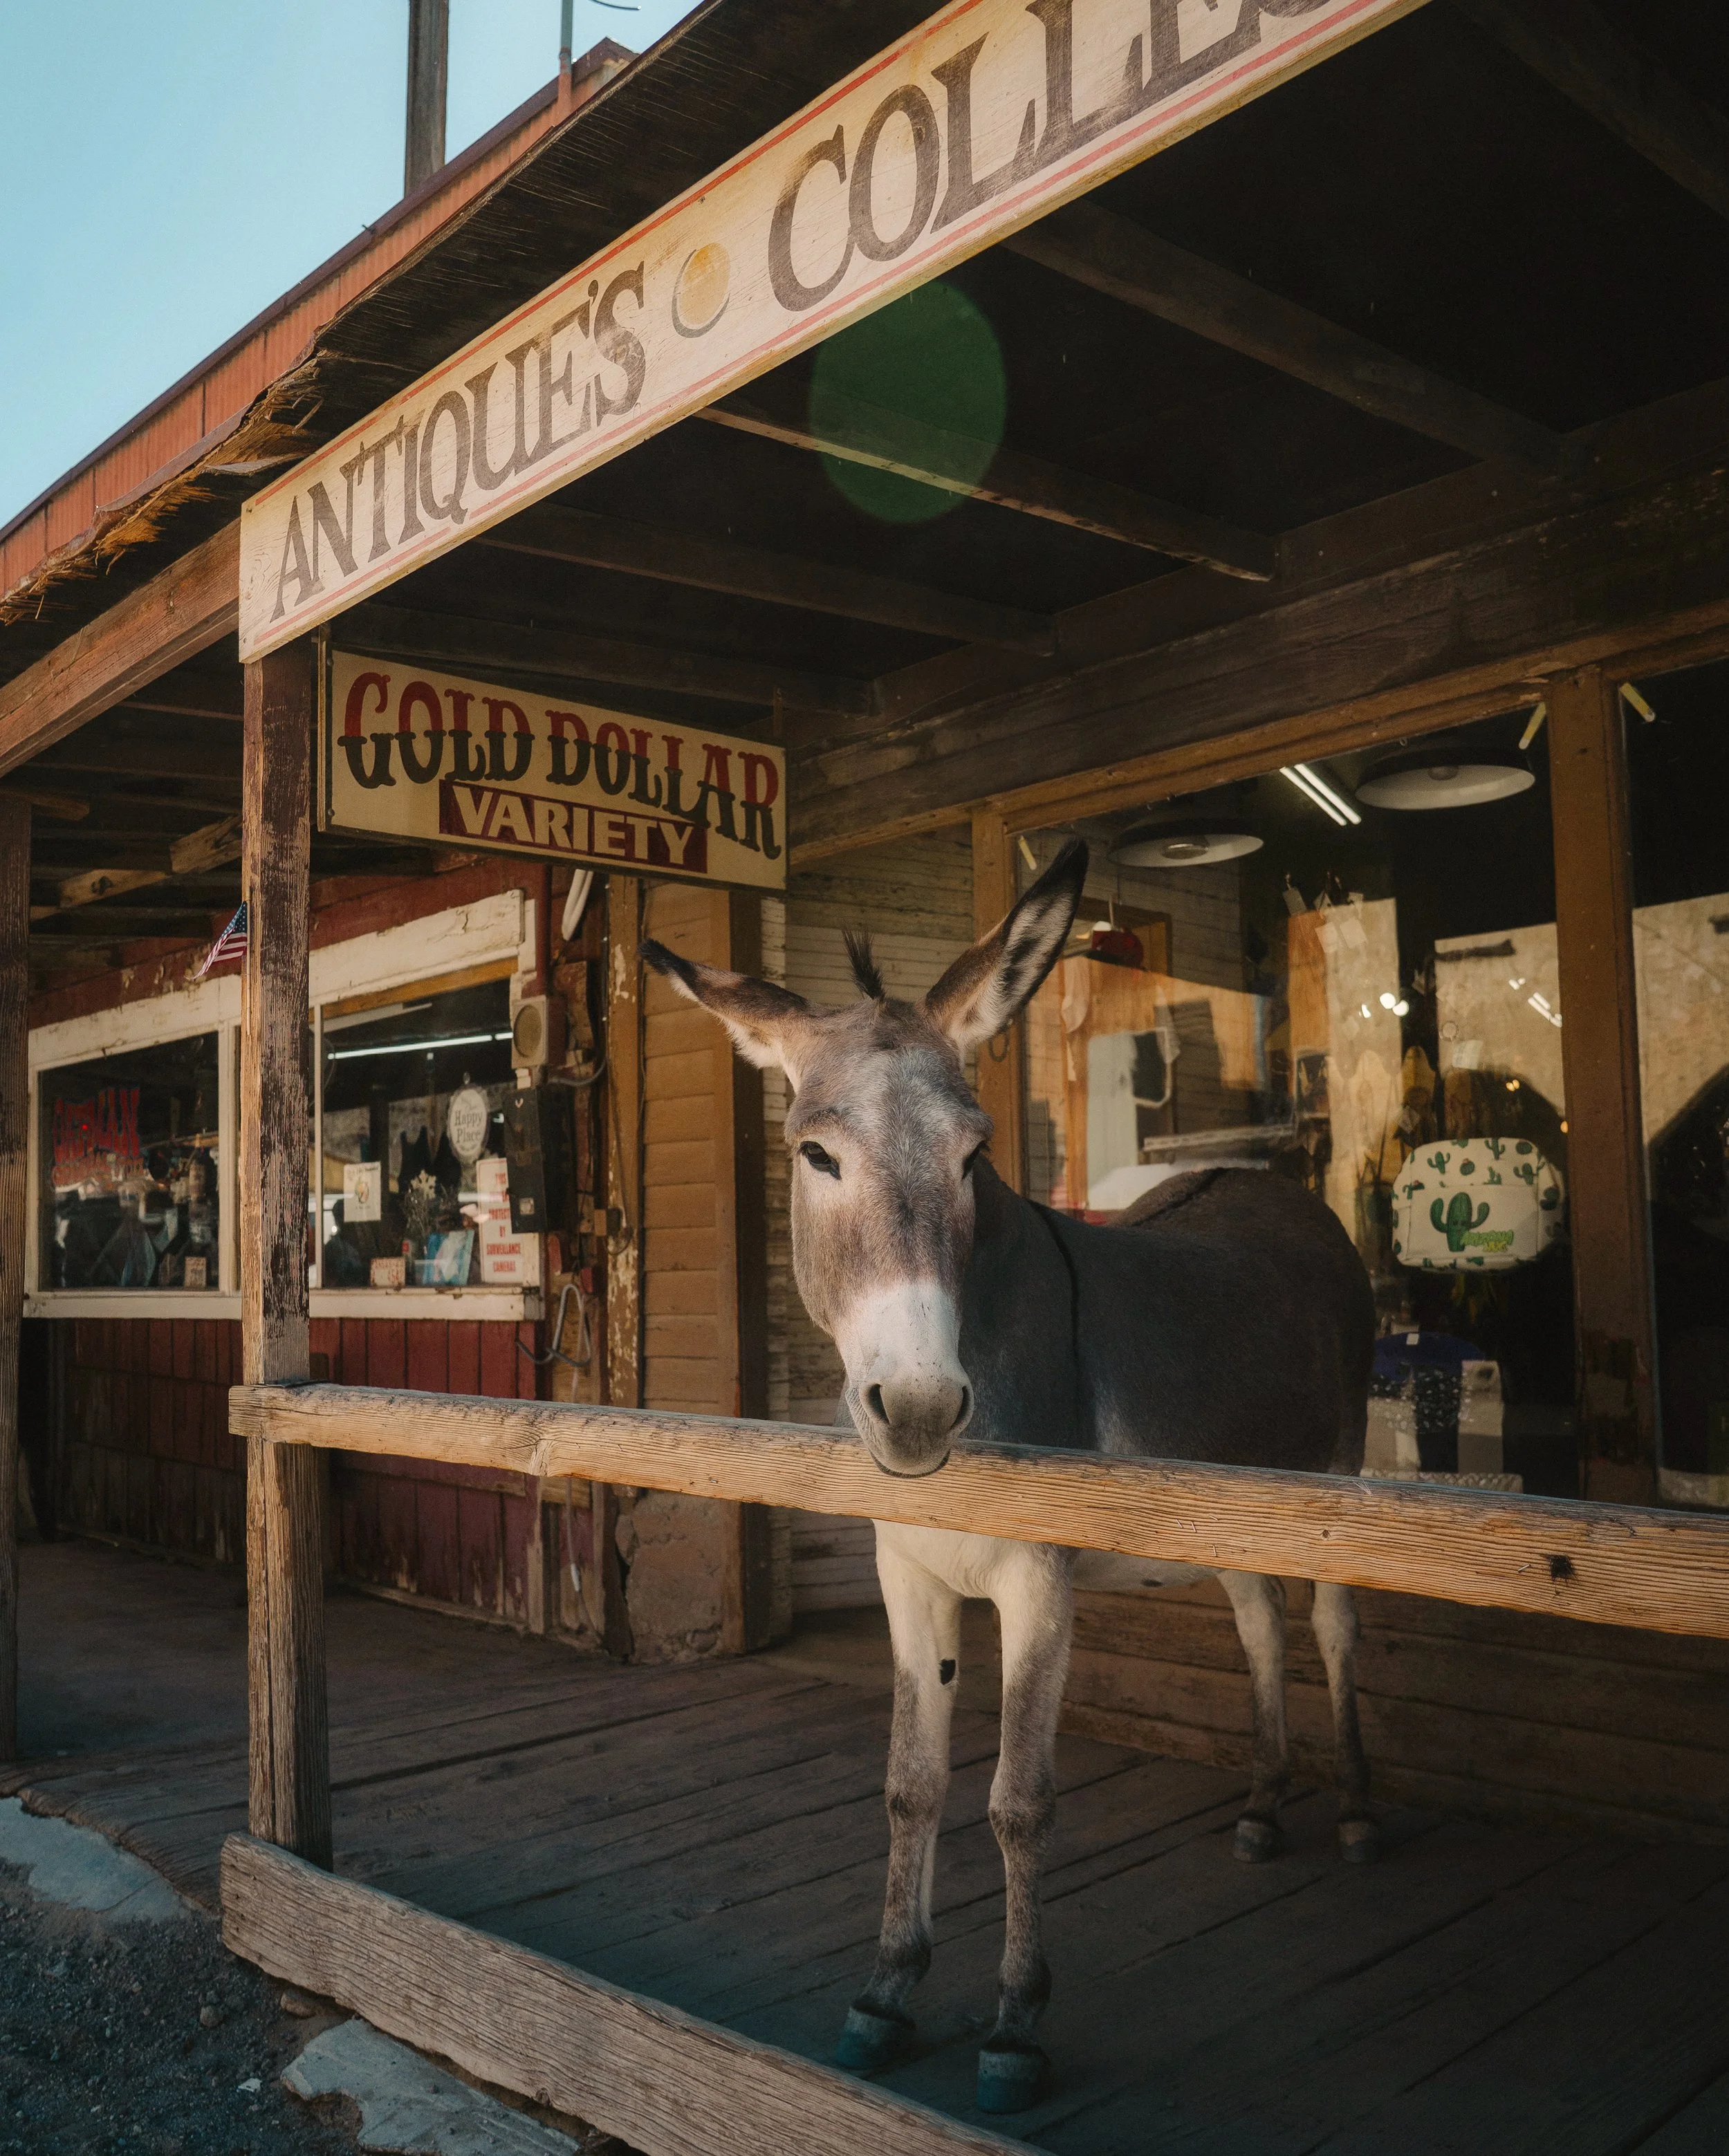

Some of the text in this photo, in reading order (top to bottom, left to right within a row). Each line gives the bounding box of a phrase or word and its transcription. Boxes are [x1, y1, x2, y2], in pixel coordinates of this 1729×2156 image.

[270, 0, 1329, 621] ANTIQUE'S COLLE
[337, 671, 782, 859] GOLD DOLLAR
[453, 785, 694, 864] VARIETY
[454, 1110, 483, 1128] Happy
[456, 1128, 481, 1143] Place
[489, 1207, 510, 1220] PROTECT
[487, 1243, 521, 1256] SURVEILLANCE
